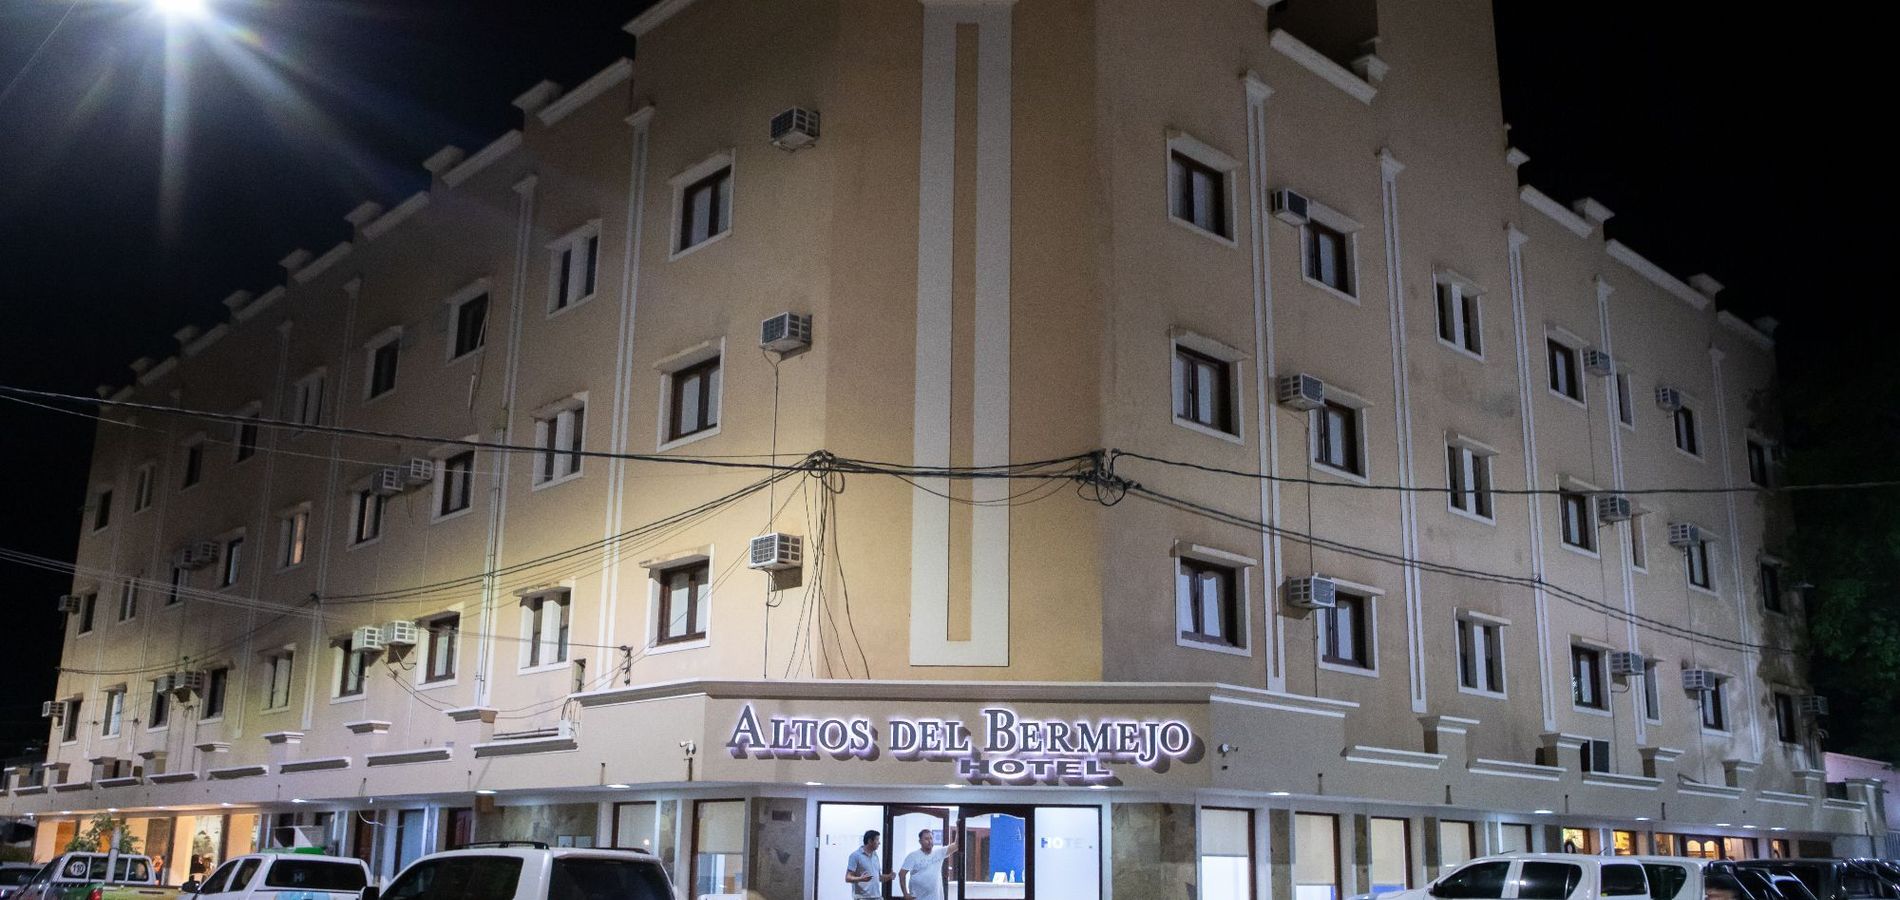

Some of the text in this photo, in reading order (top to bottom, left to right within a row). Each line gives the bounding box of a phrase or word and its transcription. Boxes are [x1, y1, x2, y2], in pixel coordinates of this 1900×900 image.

[726, 704, 1190, 762] ALTOS DEL BERMEJO
[960, 759, 1110, 775] HOTEL
[1040, 837, 1093, 849] HOTE
